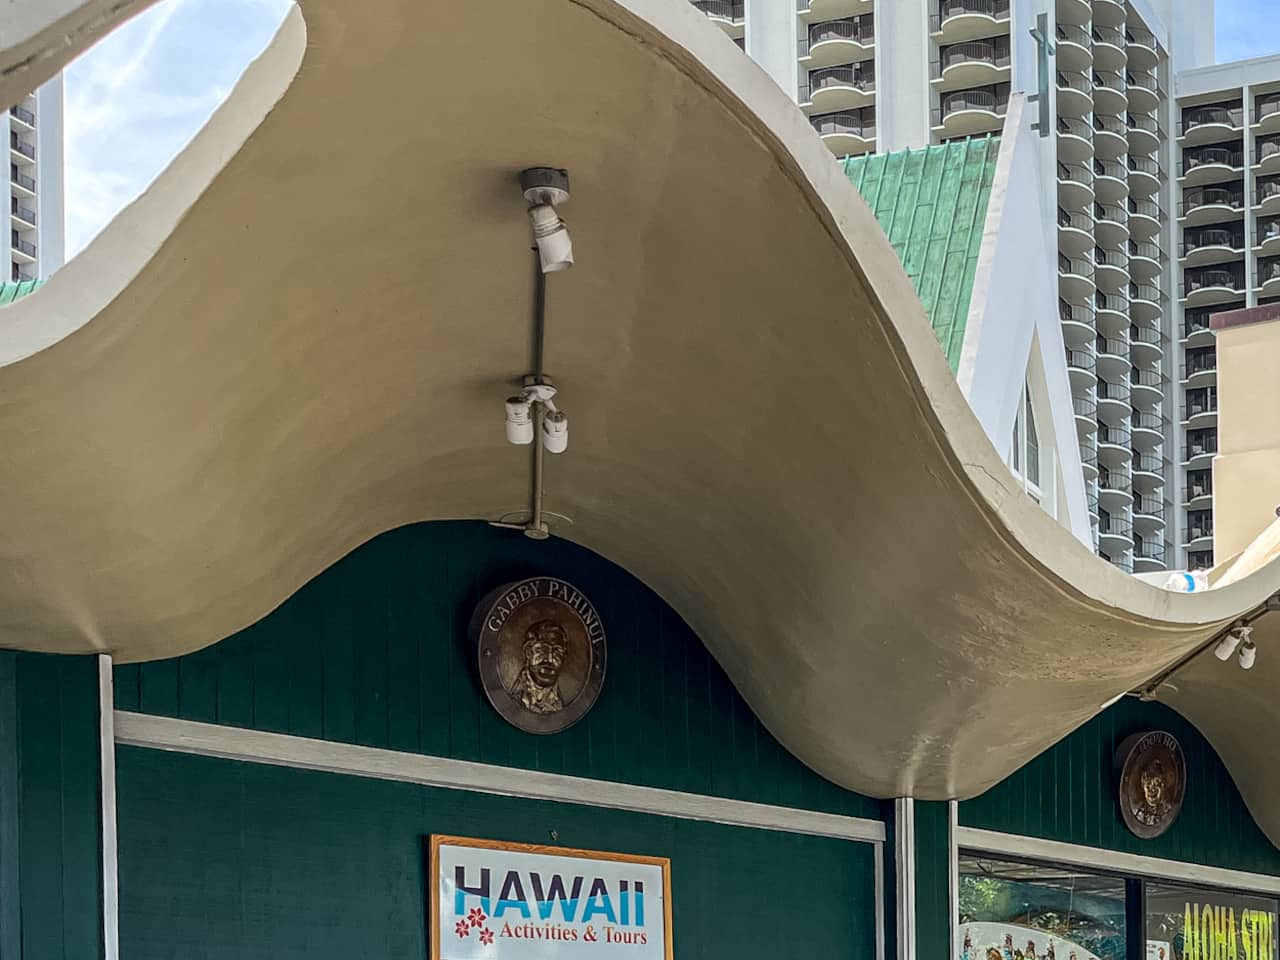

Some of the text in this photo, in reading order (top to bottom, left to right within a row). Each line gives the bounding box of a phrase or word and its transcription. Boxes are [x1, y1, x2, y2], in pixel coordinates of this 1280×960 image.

[489, 581, 604, 644] GABBY PAHINUI
[455, 866, 644, 926] HAWAII
[500, 921, 647, 945] Activities & Tours
